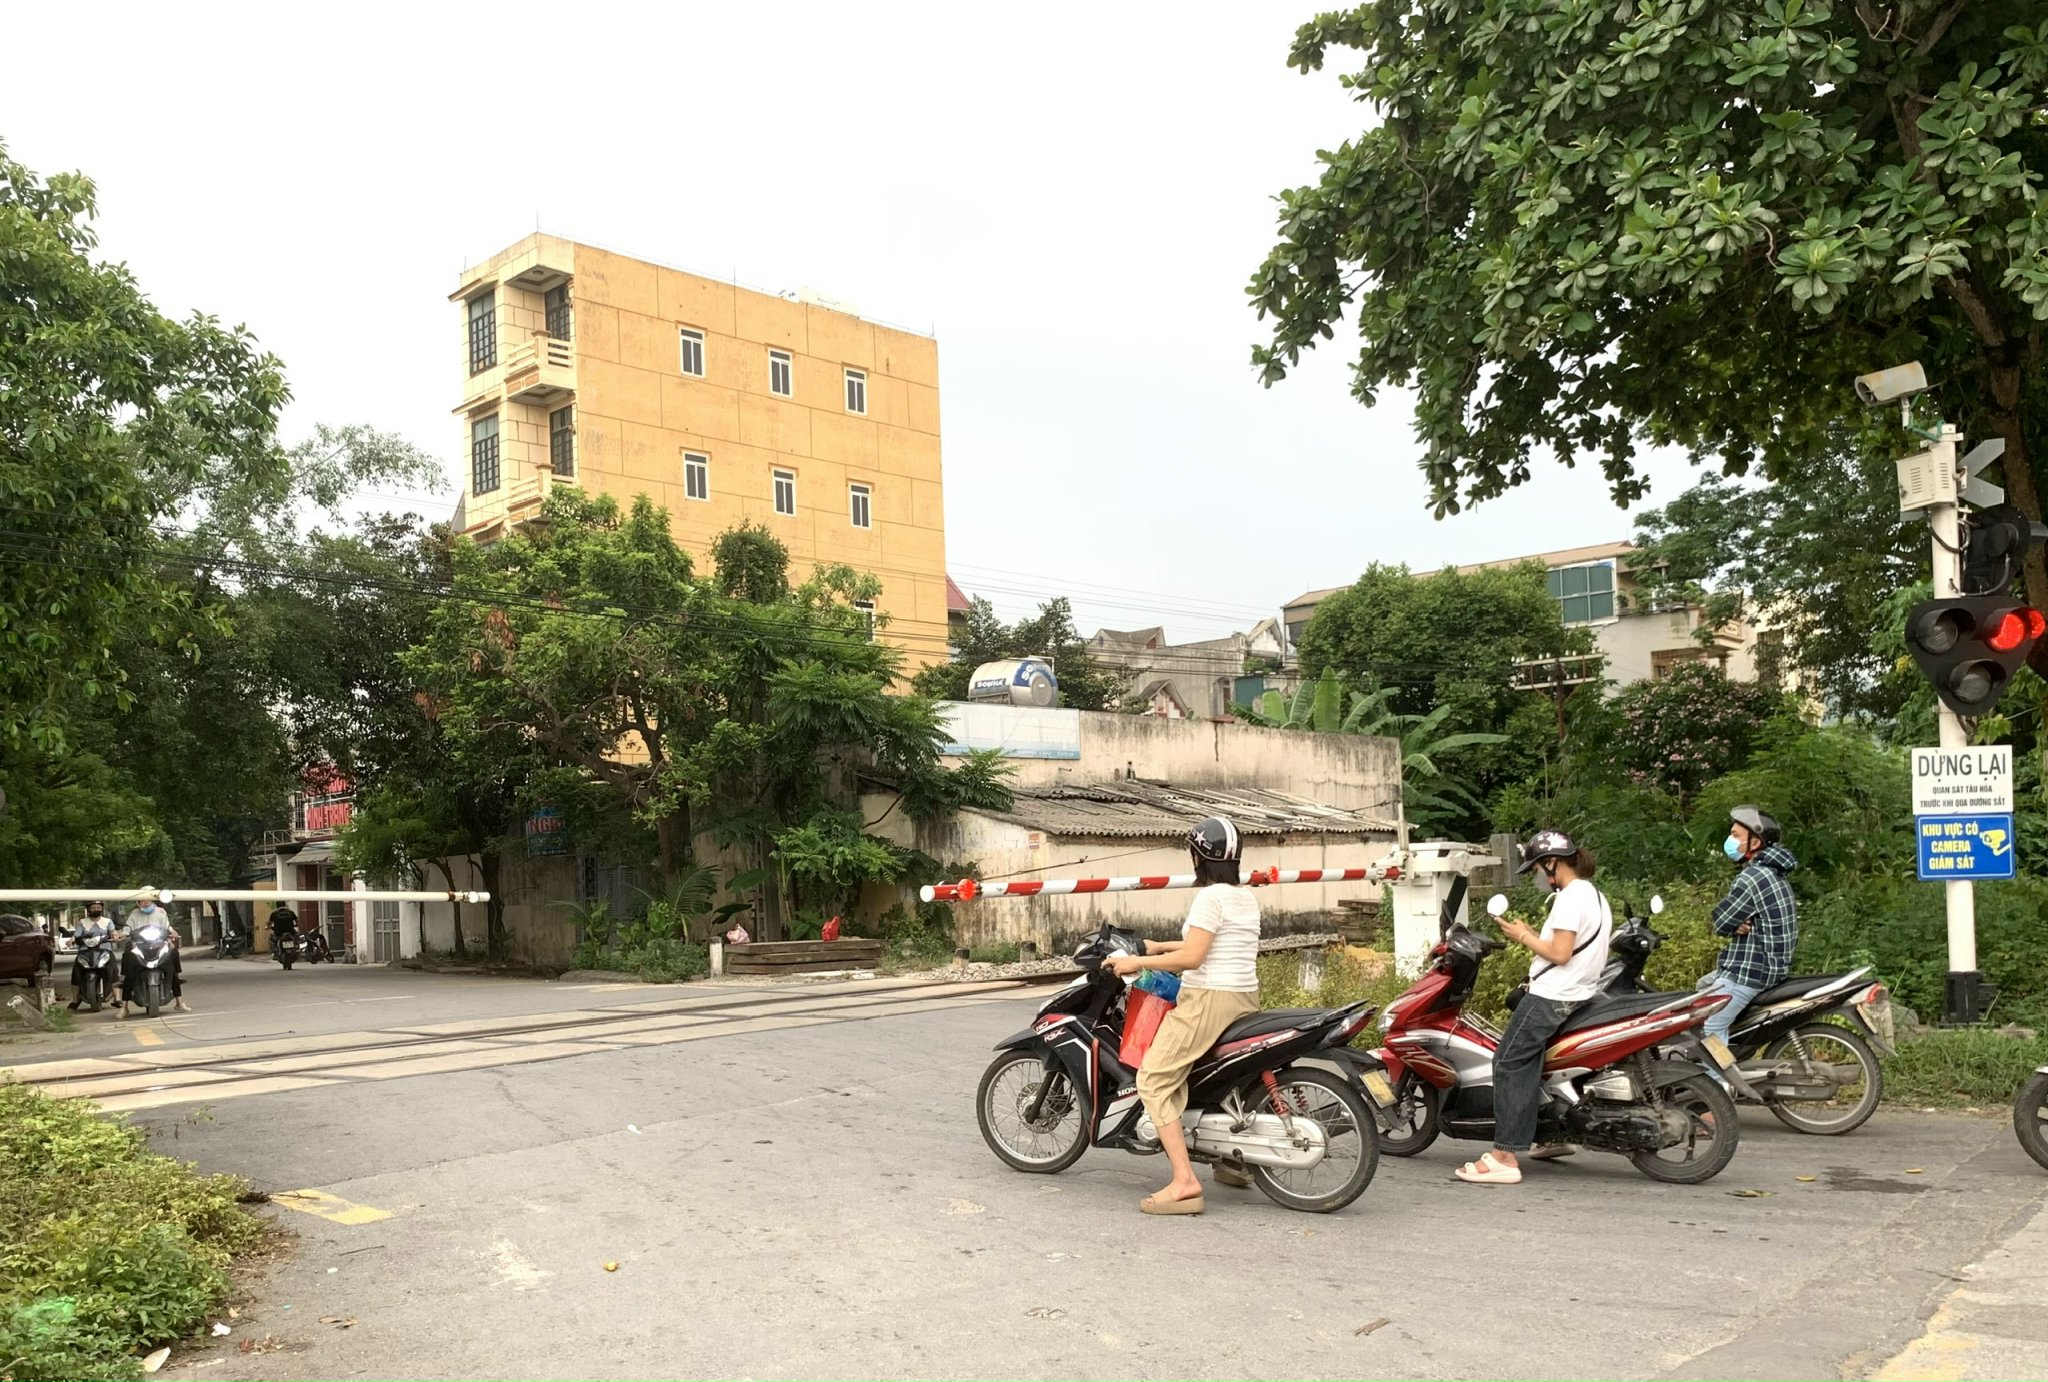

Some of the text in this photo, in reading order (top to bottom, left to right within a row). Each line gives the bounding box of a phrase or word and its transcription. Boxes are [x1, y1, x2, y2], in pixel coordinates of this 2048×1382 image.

[1918, 749, 2006, 781] DỪNG LẠI
[1932, 786, 1950, 794] QUAN
[1951, 785, 1964, 793] SÁT
[1942, 799, 1954, 807] KHI
[1955, 798, 1968, 807] QUA
[1922, 820, 1979, 839] KHU VỰC CÓ
[1931, 840, 1971, 853] CAMERA
[1929, 854, 1975, 870] GIÁM SÁT
